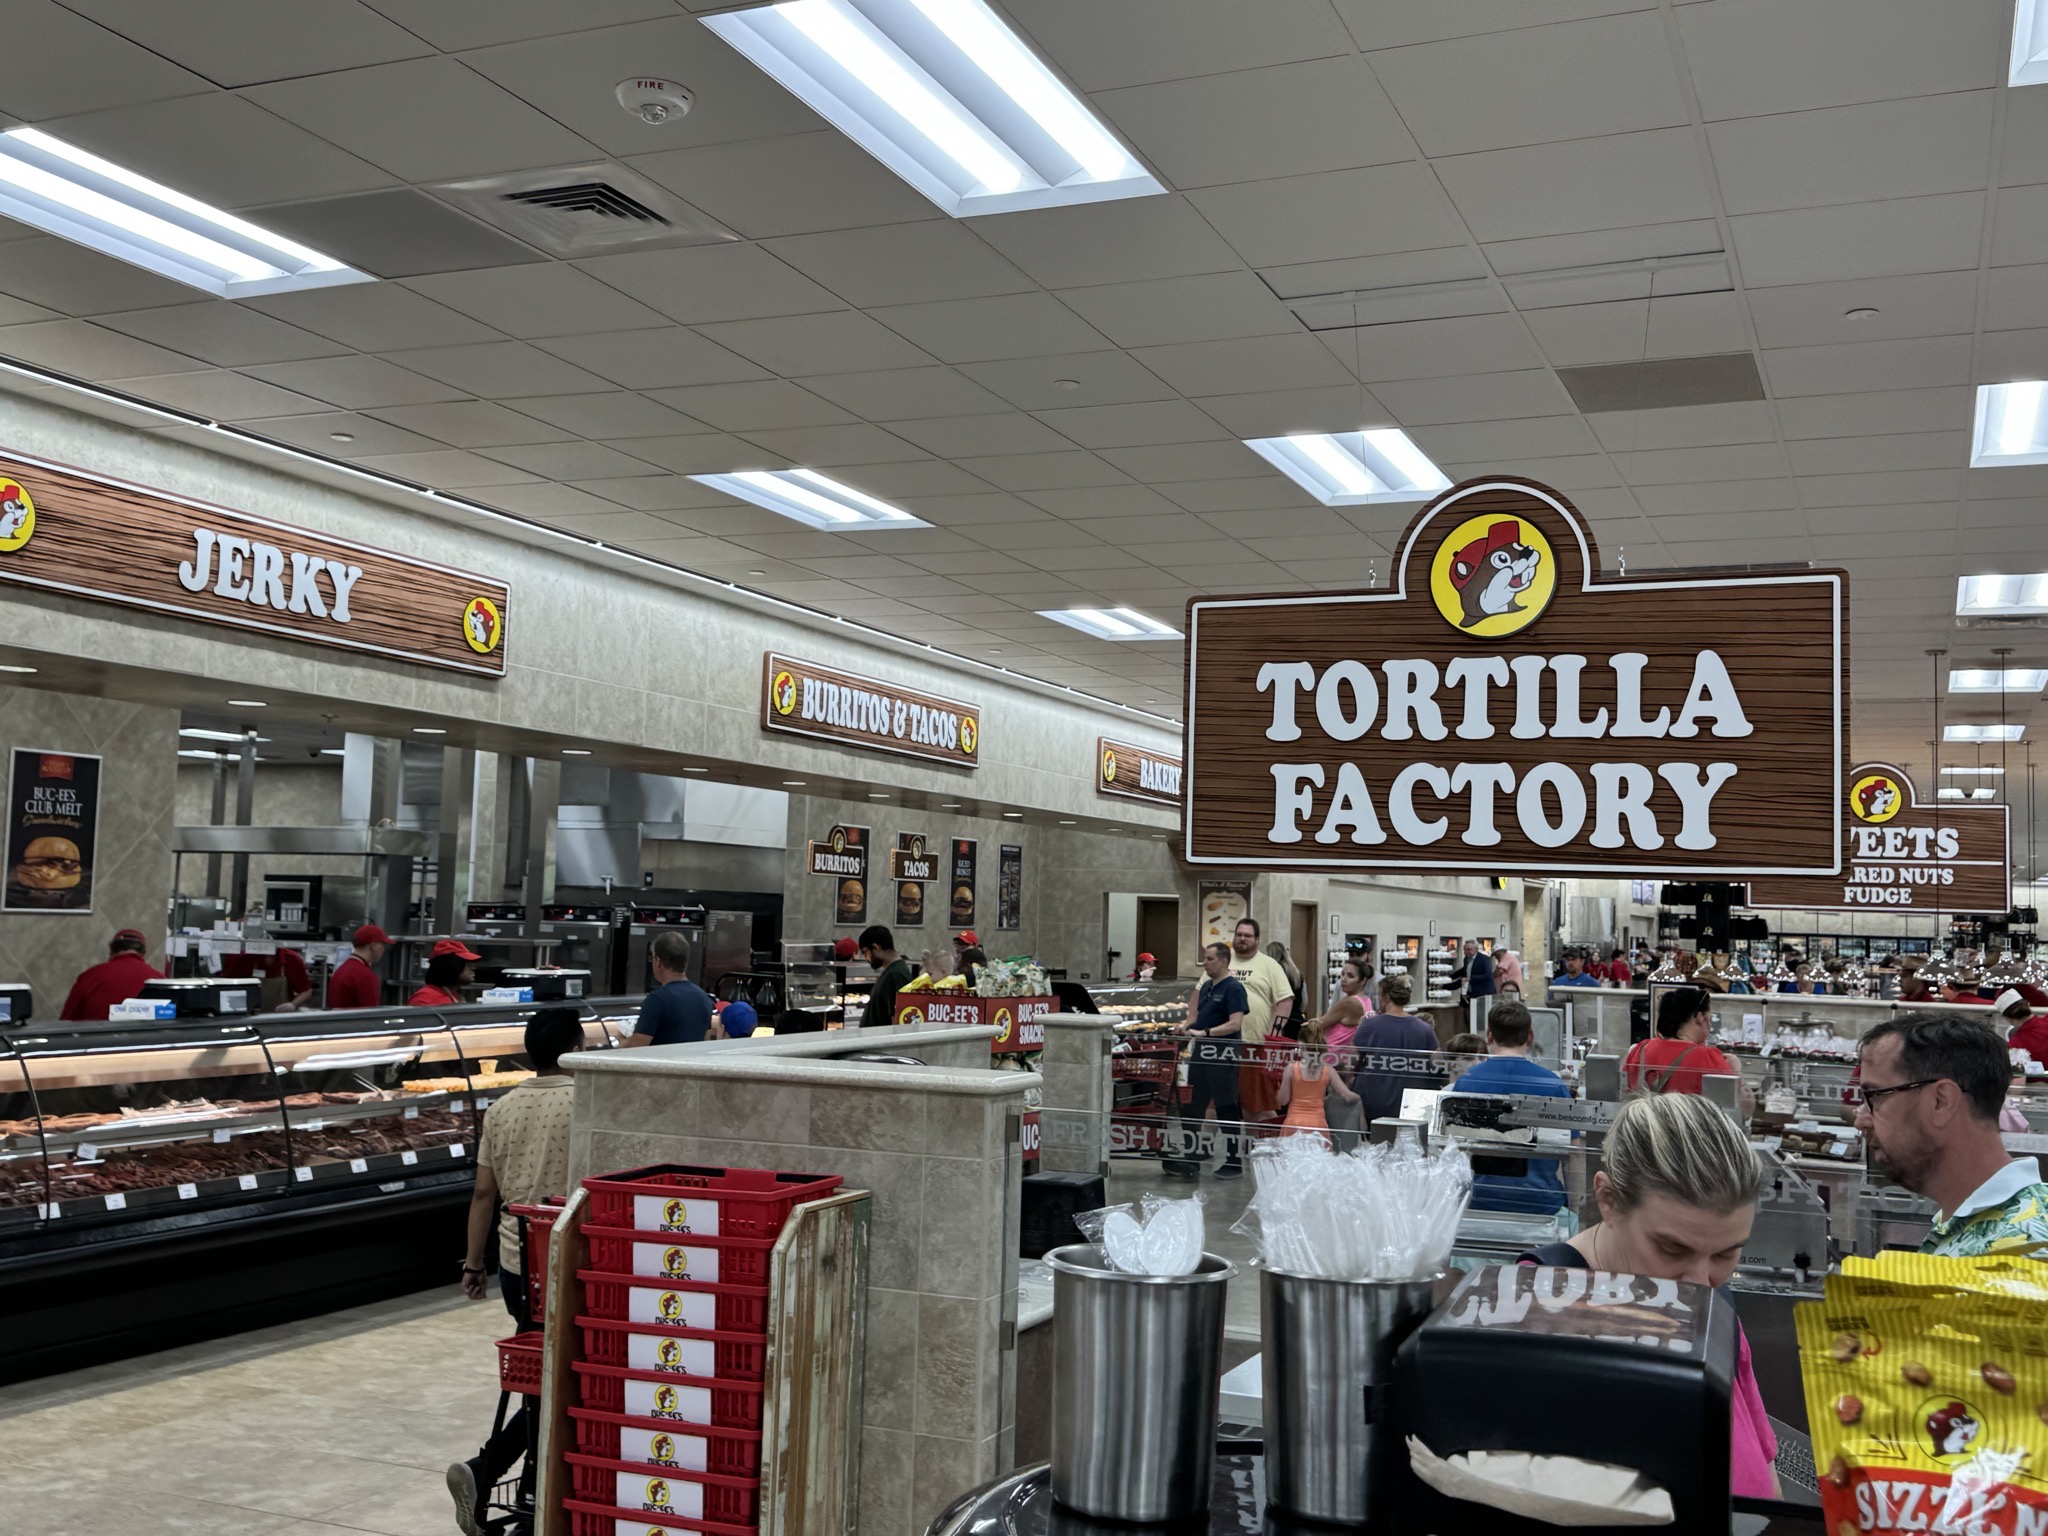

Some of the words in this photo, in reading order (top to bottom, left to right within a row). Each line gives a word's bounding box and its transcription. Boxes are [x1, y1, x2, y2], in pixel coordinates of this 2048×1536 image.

[637, 80, 664, 91] FIRE
[178, 527, 363, 623] JERKY
[1256, 650, 1754, 742] TORTILLA
[801, 677, 890, 736] BURRITOS
[892, 699, 907, 739] &
[909, 703, 958, 750] TACOS
[1140, 757, 1182, 796] BAKERY
[24, 799, 53, 814] CLUB
[55, 803, 83, 816] MELT
[1268, 762, 1738, 850] FACTORY
[1851, 826, 1960, 859] EETS
[814, 852, 860, 873] BURRITOS
[903, 860, 930, 877] TACOS
[1899, 867, 1954, 885] NUTS
[1843, 886, 1913, 904] FUDGE
[928, 1003, 979, 1023] BUC-EE'S
[1051, 1119, 1151, 1151] FRSH
